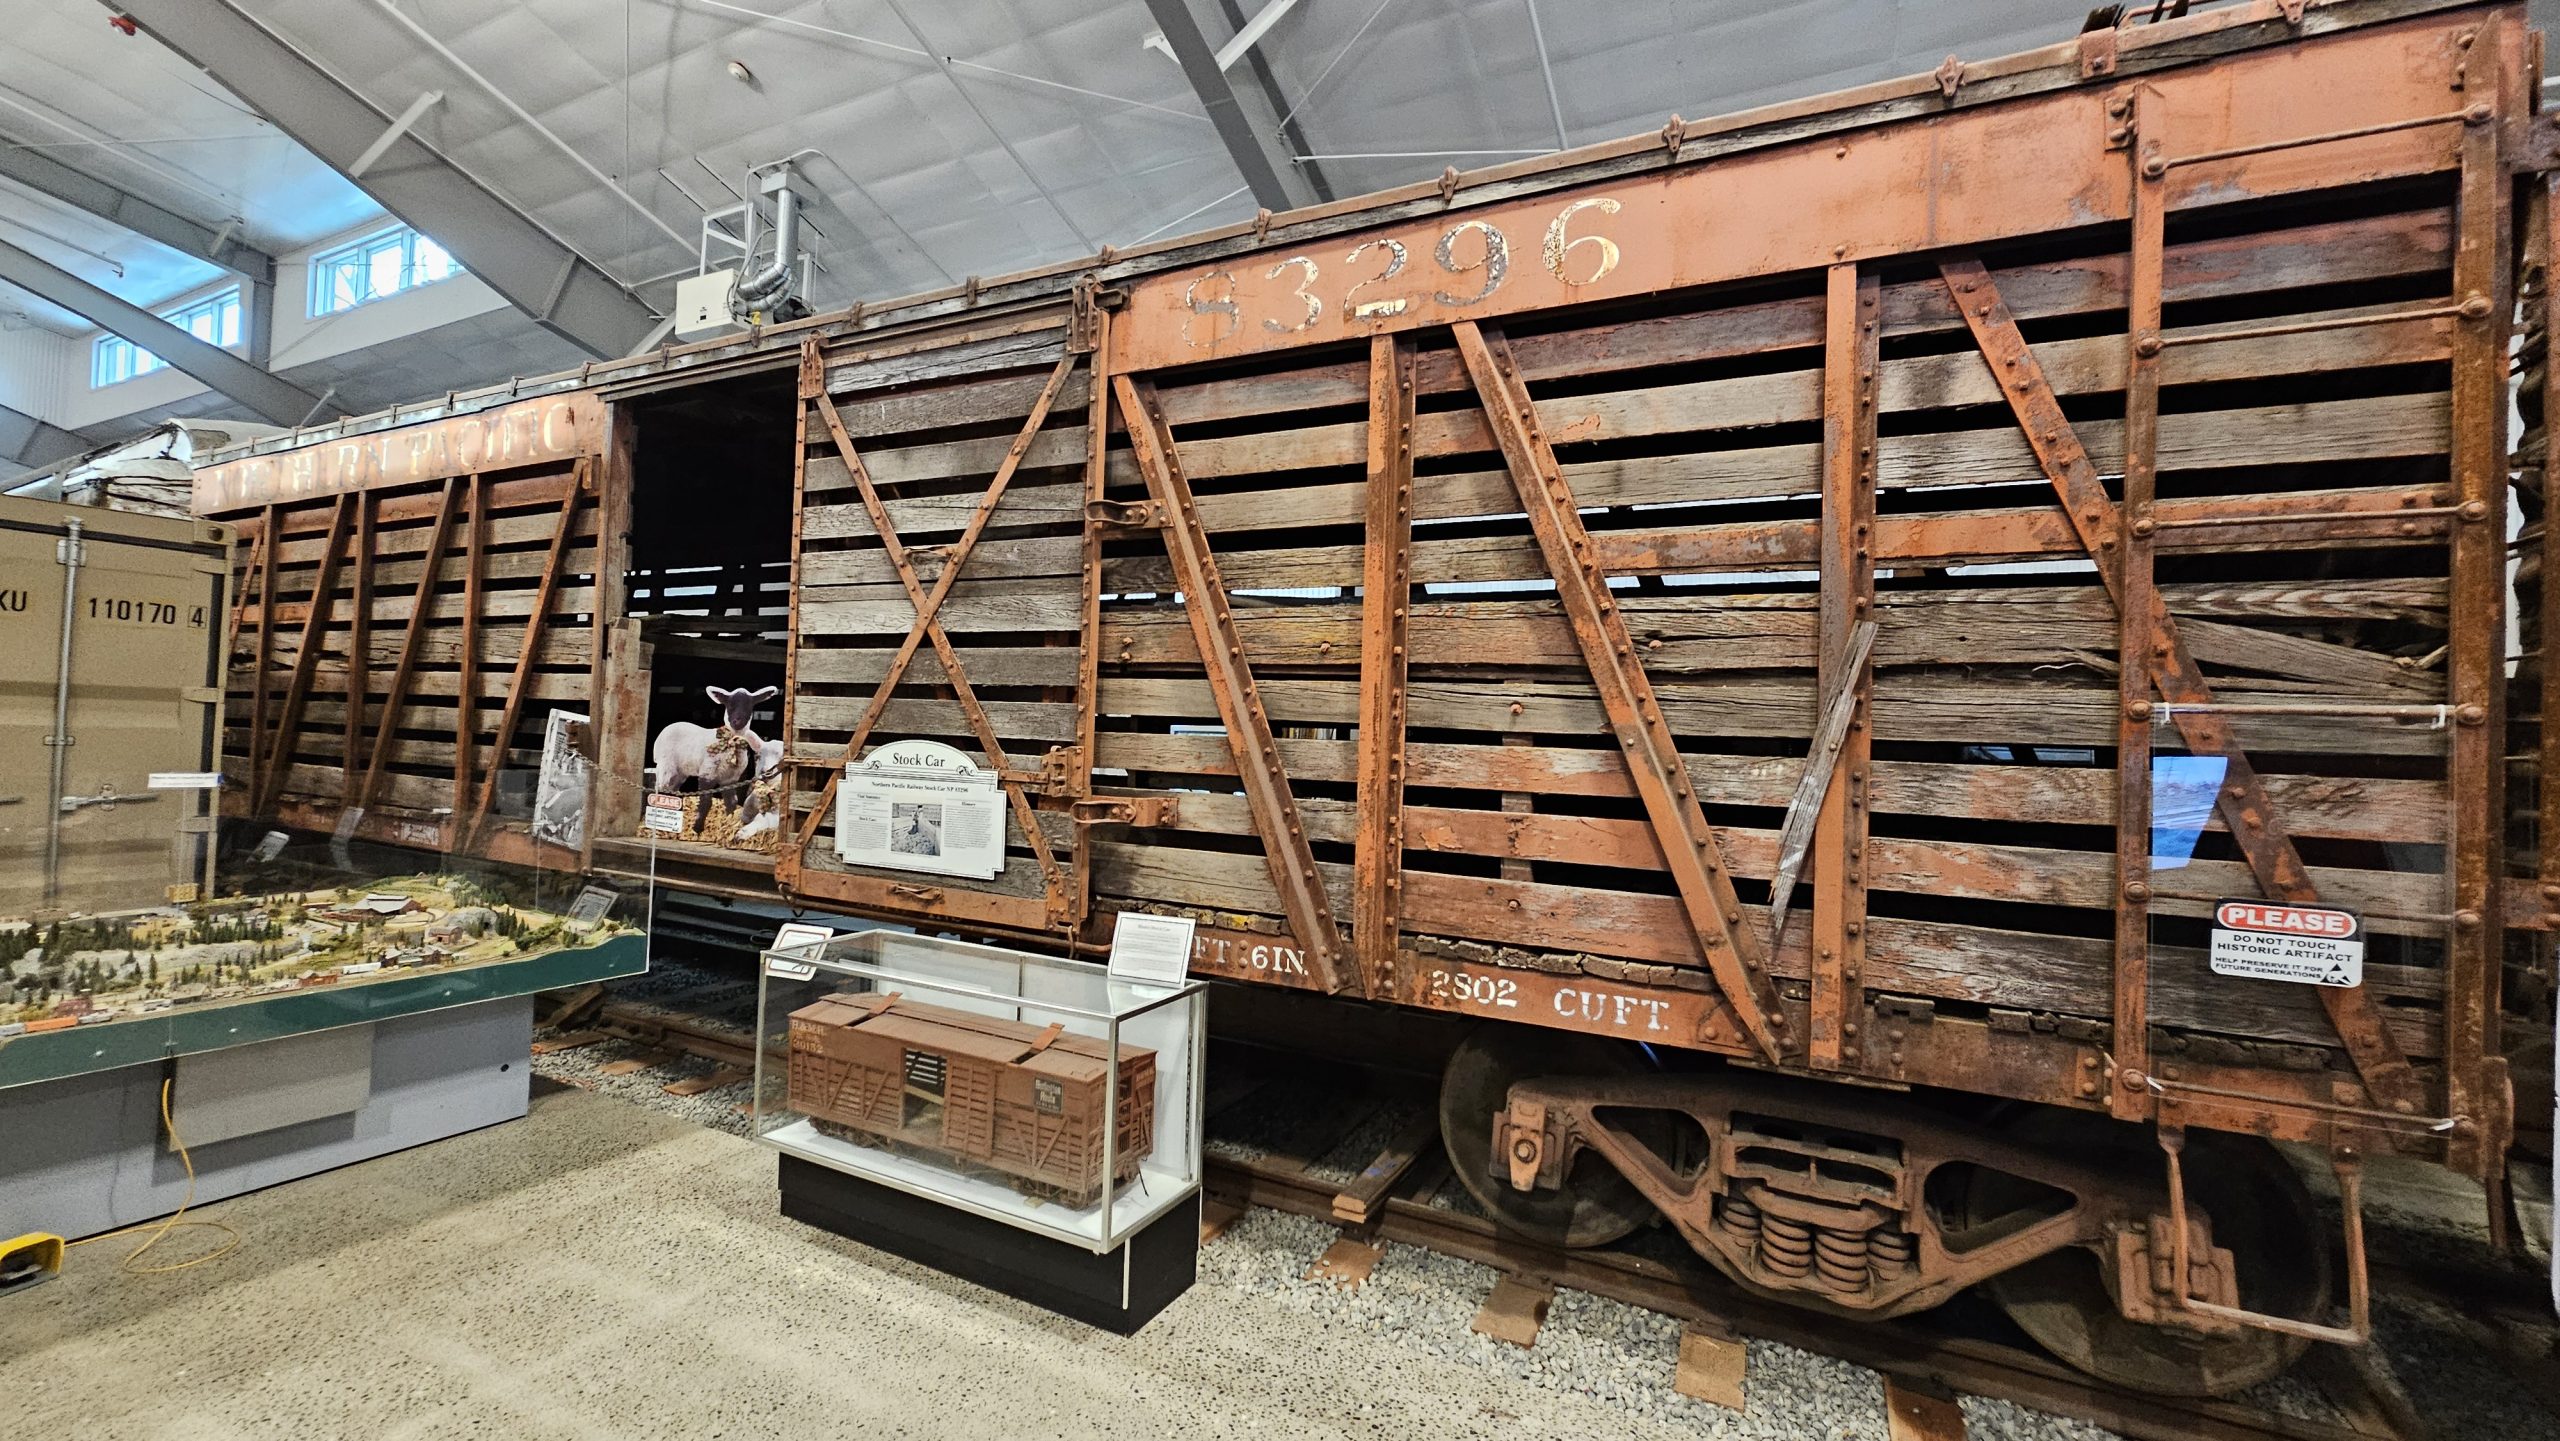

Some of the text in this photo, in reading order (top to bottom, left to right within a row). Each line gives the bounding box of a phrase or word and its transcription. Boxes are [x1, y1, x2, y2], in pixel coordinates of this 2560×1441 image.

[1181, 197, 1621, 348] 83296
[89, 597, 176, 625] 110170
[191, 607, 204, 627] 4
[892, 752, 946, 767] Stock Car
[2228, 907, 2344, 933] PLEASE
[2217, 943, 2353, 962] HISTORIC ARTIFACT
[2233, 934, 2336, 950] DO NOT TOUCH
[1193, 935, 1231, 964] FT
[1251, 945, 1310, 976] 6IN.
[2241, 959, 2289, 969] PRESERVE
[2215, 963, 2322, 979] FUTURE GENERATIONS
[1432, 969, 1518, 1008] 2802
